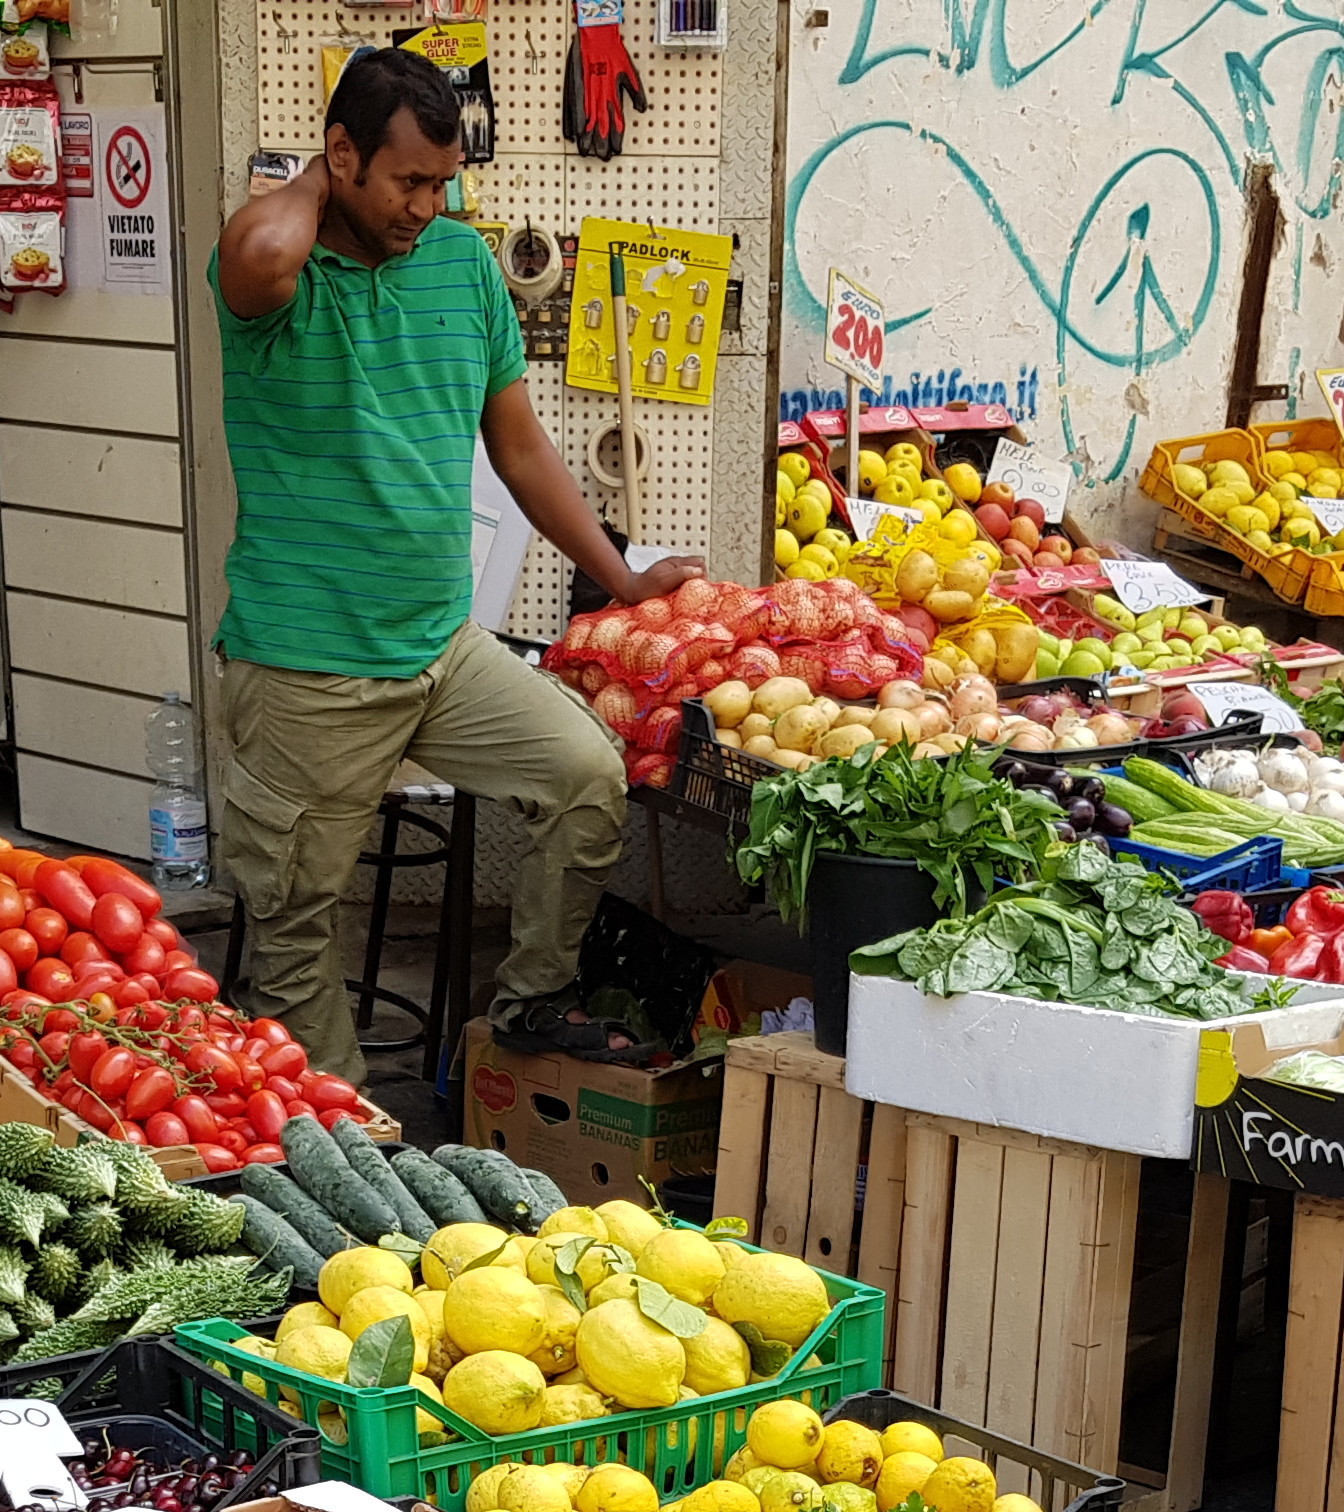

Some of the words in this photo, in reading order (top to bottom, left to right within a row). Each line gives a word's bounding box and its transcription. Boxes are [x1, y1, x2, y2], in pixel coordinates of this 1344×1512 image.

[422, 38, 459, 49] SUPER
[426, 47, 457, 58] GLUE
[253, 165, 288, 176] DURACELL
[108, 214, 155, 234] VIETATO
[109, 239, 155, 258] FUMARE
[620, 241, 692, 262] PADLOCK
[840, 289, 881, 320] EURO
[580, 1104, 633, 1130] Premium
[579, 1122, 641, 1151] BANANAS
